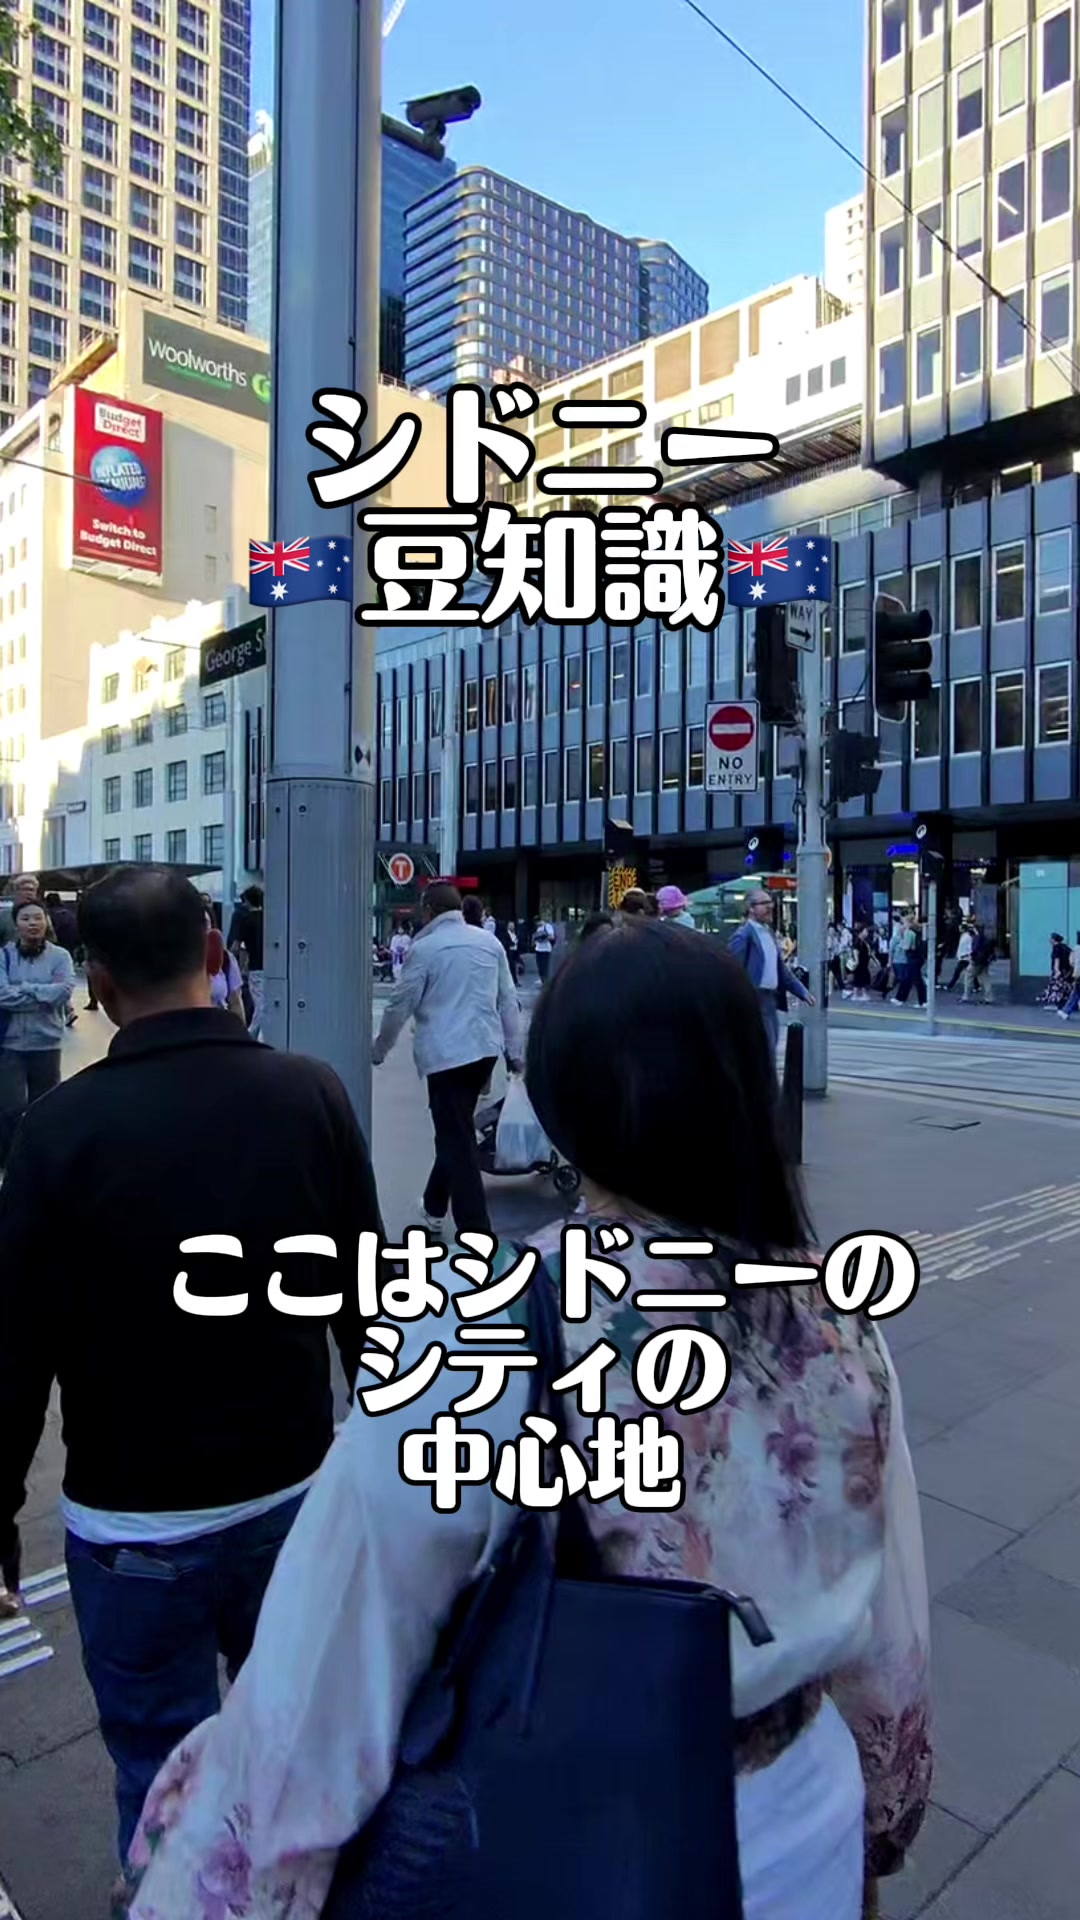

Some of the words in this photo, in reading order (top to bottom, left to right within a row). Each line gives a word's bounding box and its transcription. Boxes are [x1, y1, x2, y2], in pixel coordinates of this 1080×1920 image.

[147, 337, 248, 387] Woolworths
[98, 407, 142, 428] Budget
[102, 419, 141, 439] Direct
[92, 518, 132, 536] Switch
[133, 528, 146, 540] to
[80, 530, 122, 548] Budget
[123, 539, 157, 556] Direct
[790, 602, 813, 622] WAY
[205, 641, 252, 673] George
[718, 756, 743, 770] NO
[708, 773, 752, 786] ENTRY
[394, 860, 408, 880] T
